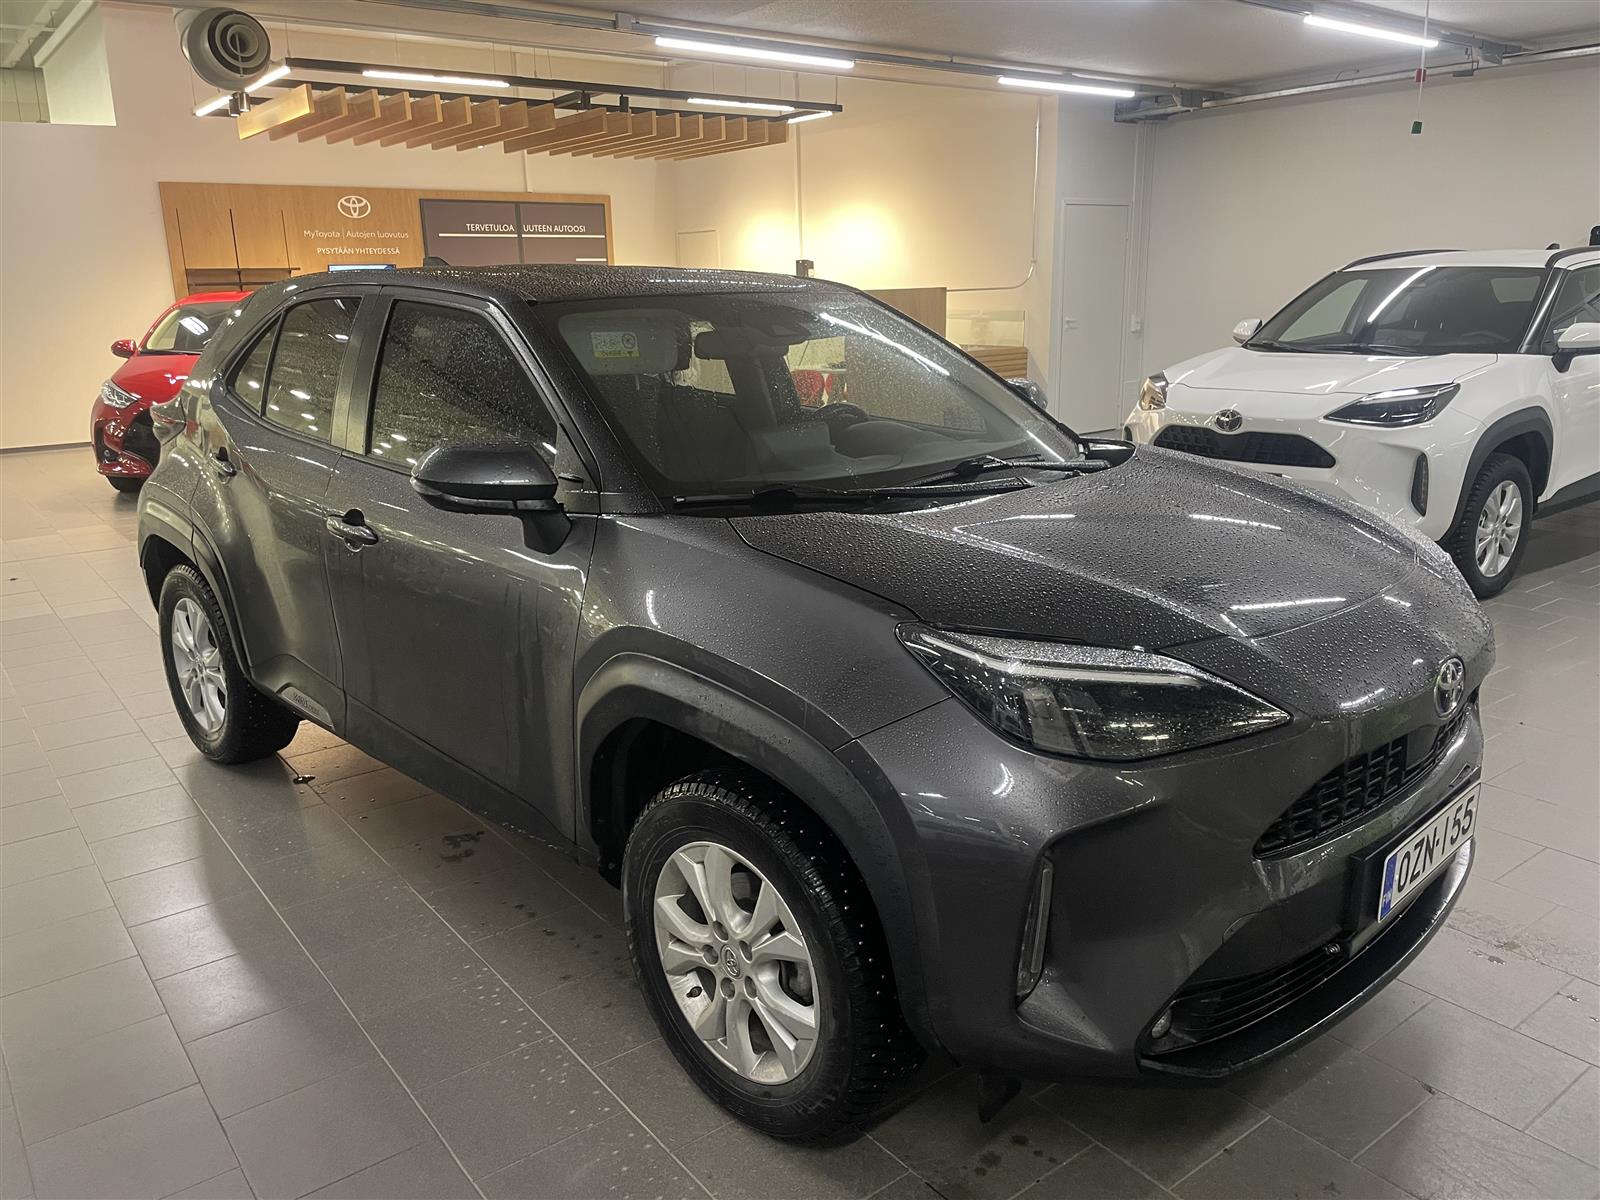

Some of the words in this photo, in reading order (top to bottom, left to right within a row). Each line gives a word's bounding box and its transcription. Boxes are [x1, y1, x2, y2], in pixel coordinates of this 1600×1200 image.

[466, 223, 515, 232] TERVETULOA
[523, 224, 552, 233] UUTEEN
[553, 225, 586, 233] AUTOOSI
[303, 229, 341, 239] MyToyota
[346, 229, 376, 239] Autojen
[316, 246, 354, 255] PYSYTÄÄN
[355, 246, 400, 255] YHTEYDESSÄ
[1397, 795, 1475, 893] OZN-155
